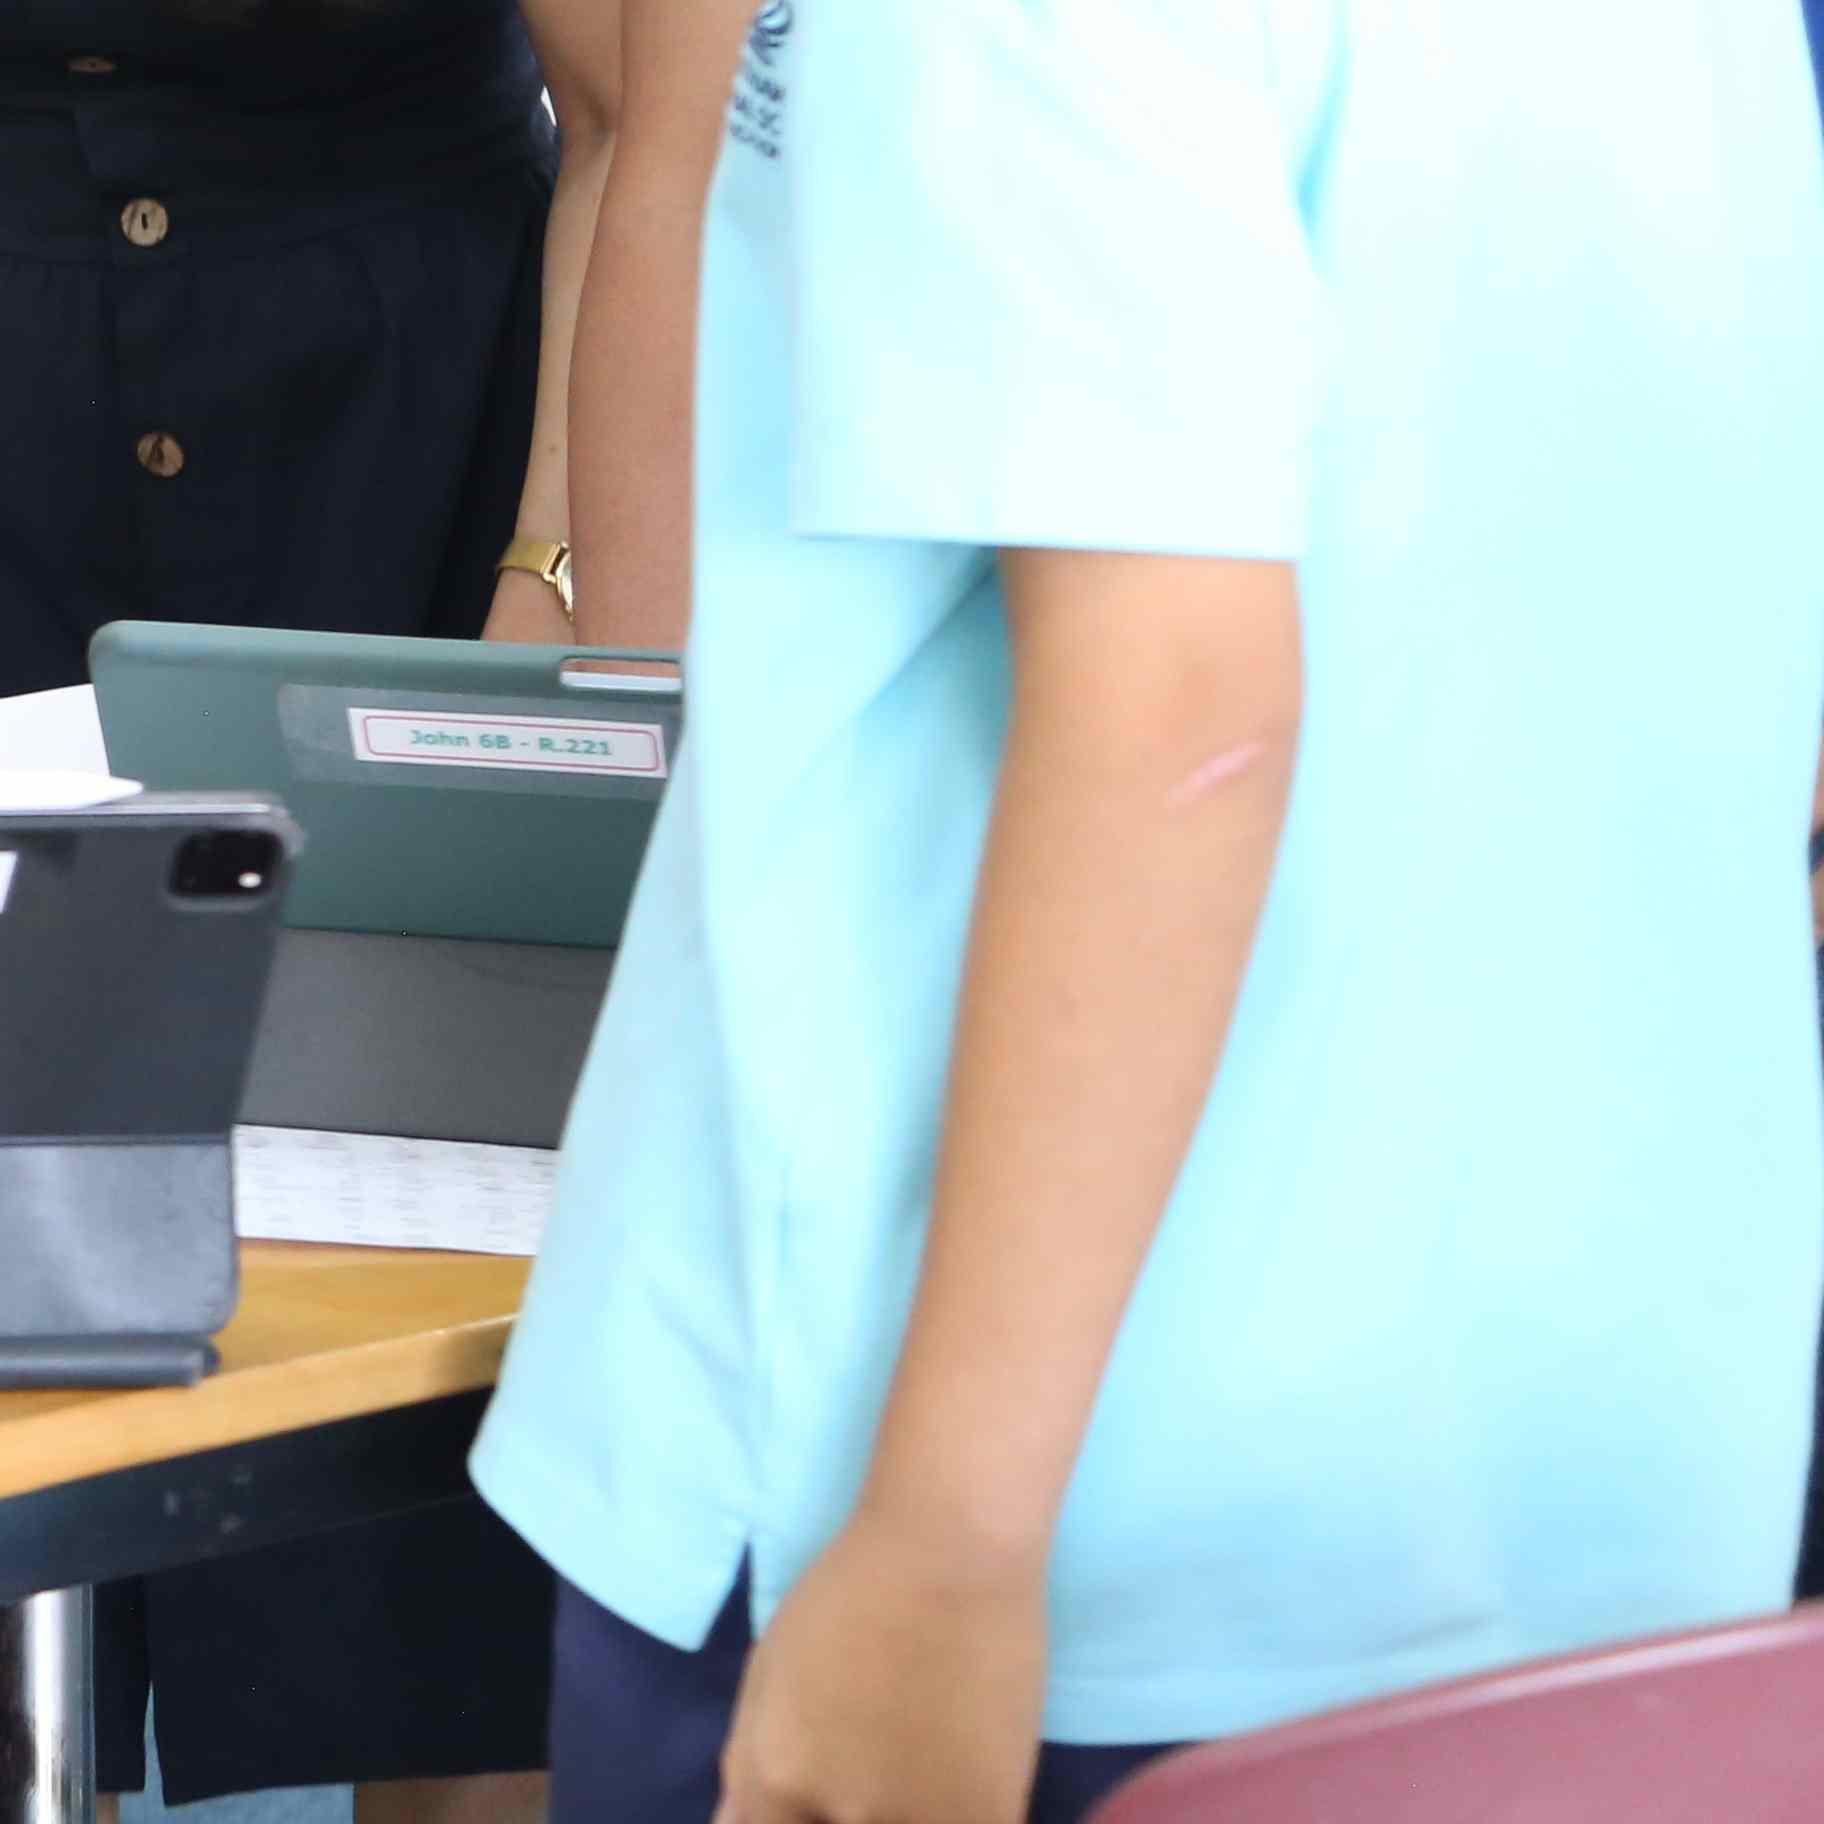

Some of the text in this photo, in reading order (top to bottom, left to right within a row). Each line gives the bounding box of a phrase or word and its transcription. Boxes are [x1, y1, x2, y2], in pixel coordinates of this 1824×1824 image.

[410, 727, 470, 750] John
[479, 733, 513, 752] 6B
[538, 736, 613, 758] R.221
